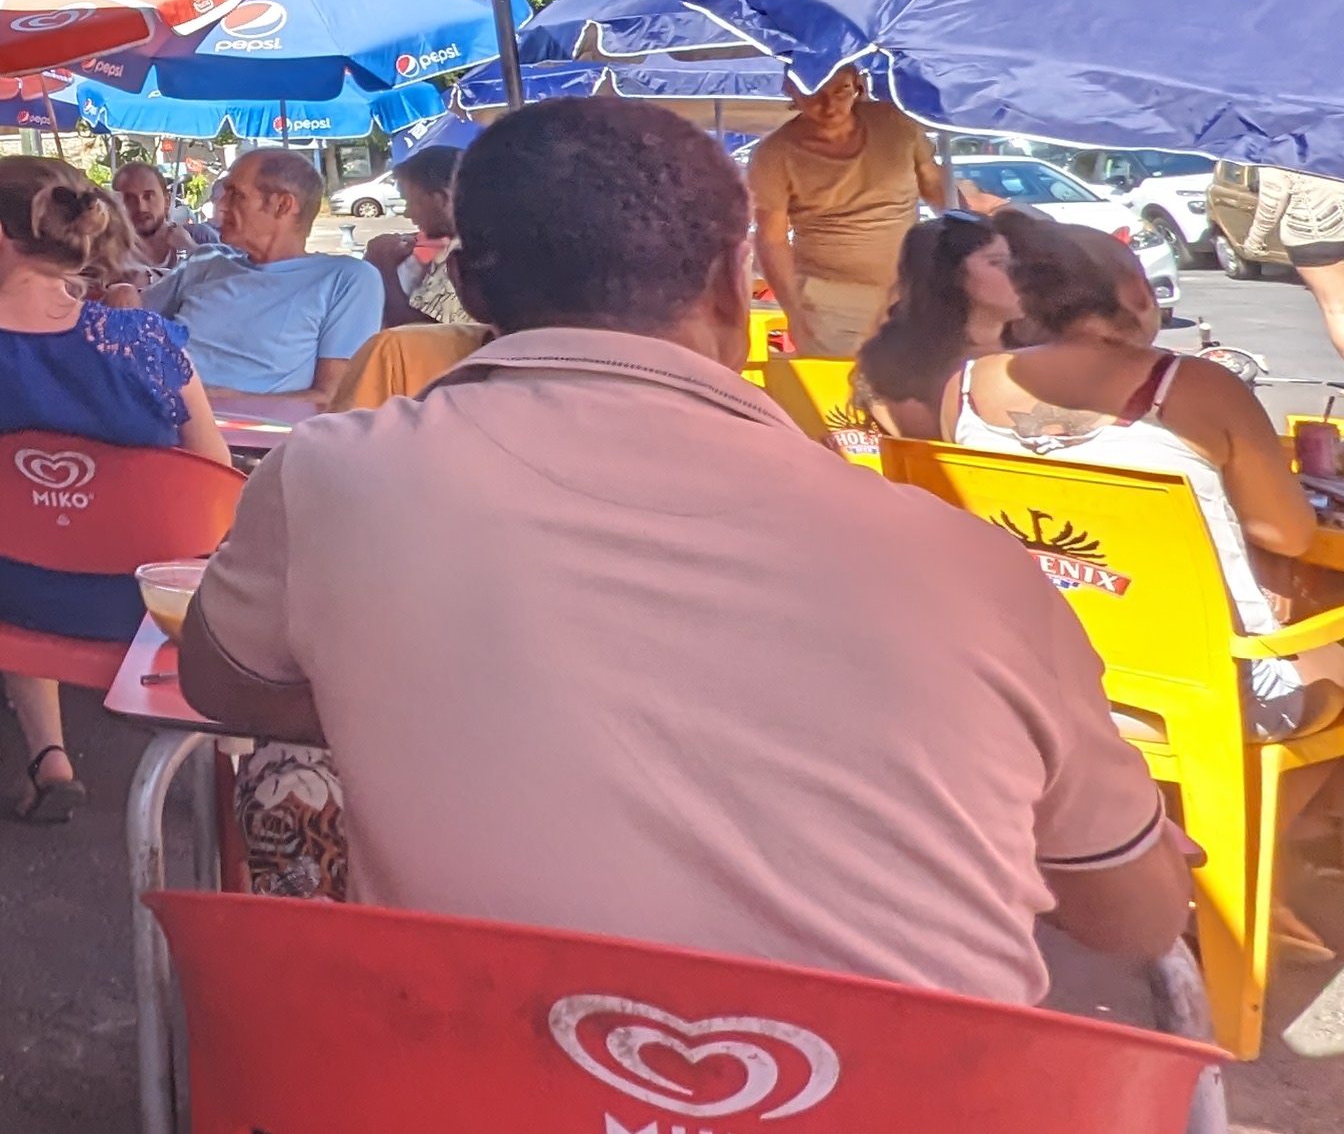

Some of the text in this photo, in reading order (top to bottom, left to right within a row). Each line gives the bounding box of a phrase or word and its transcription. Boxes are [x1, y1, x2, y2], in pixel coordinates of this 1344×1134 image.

[215, 37, 283, 53] pepsi
[418, 43, 462, 70] pepsi
[94, 59, 125, 78] pepsi
[29, 114, 51, 126] peps
[292, 117, 332, 132] pepsi
[32, 489, 89, 509] MIKO
[1038, 554, 1120, 593] ENIX
